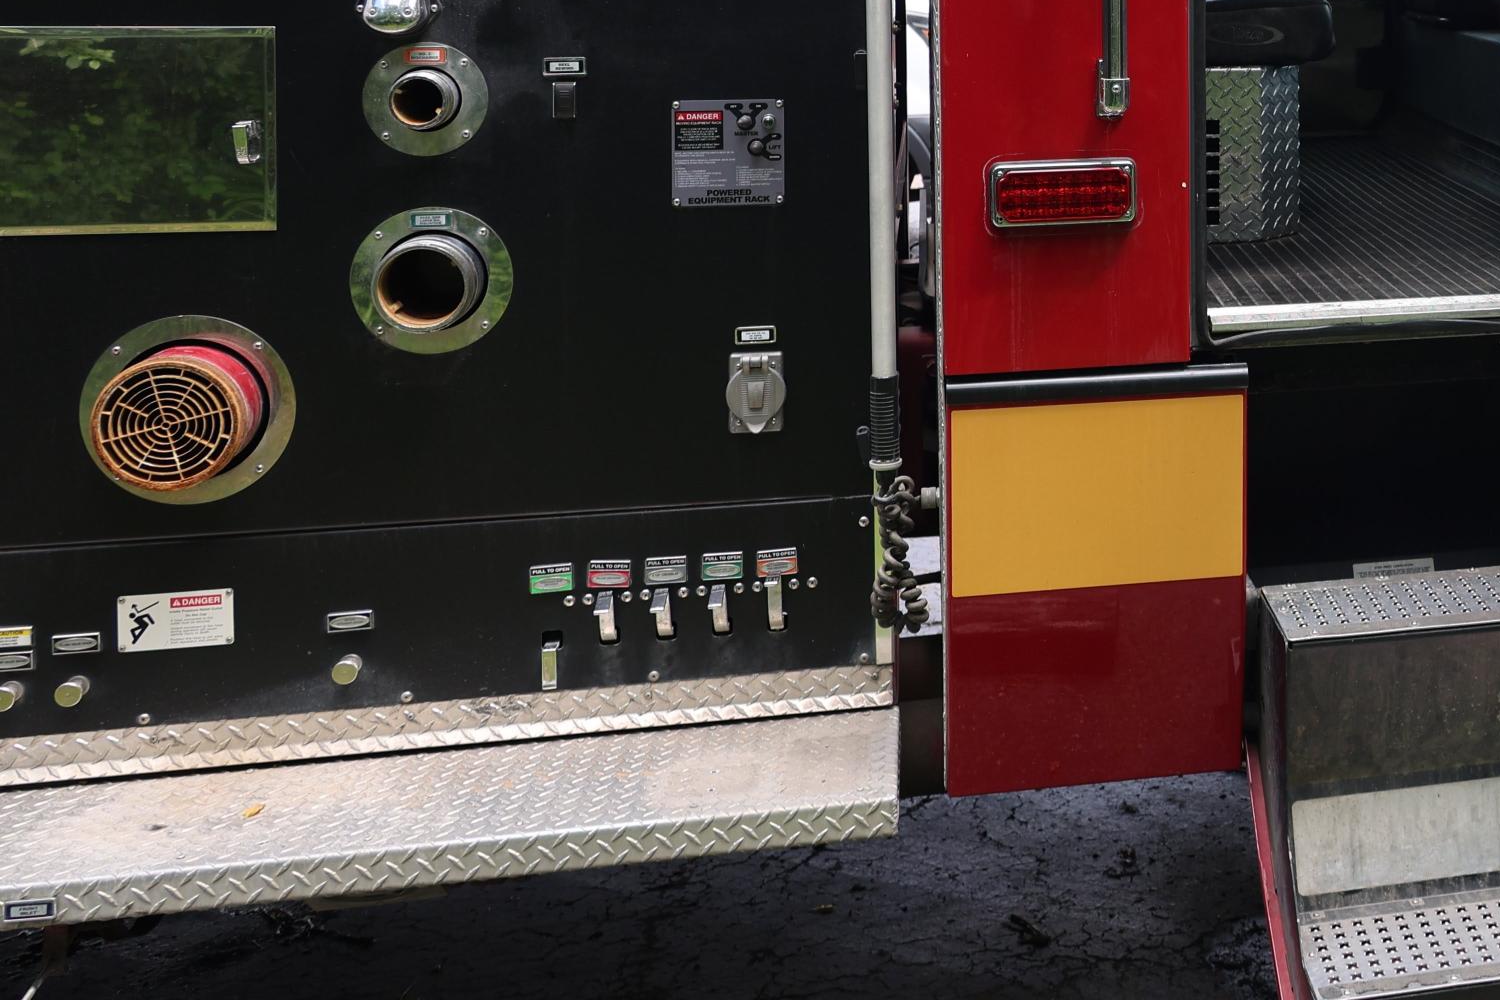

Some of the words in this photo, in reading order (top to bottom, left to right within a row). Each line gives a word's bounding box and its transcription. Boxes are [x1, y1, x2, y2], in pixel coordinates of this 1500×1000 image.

[706, 189, 752, 197] POWERED
[688, 197, 742, 205] EQUIPMENT
[744, 195, 770, 203] RACK
[182, 596, 220, 606] DANGER
